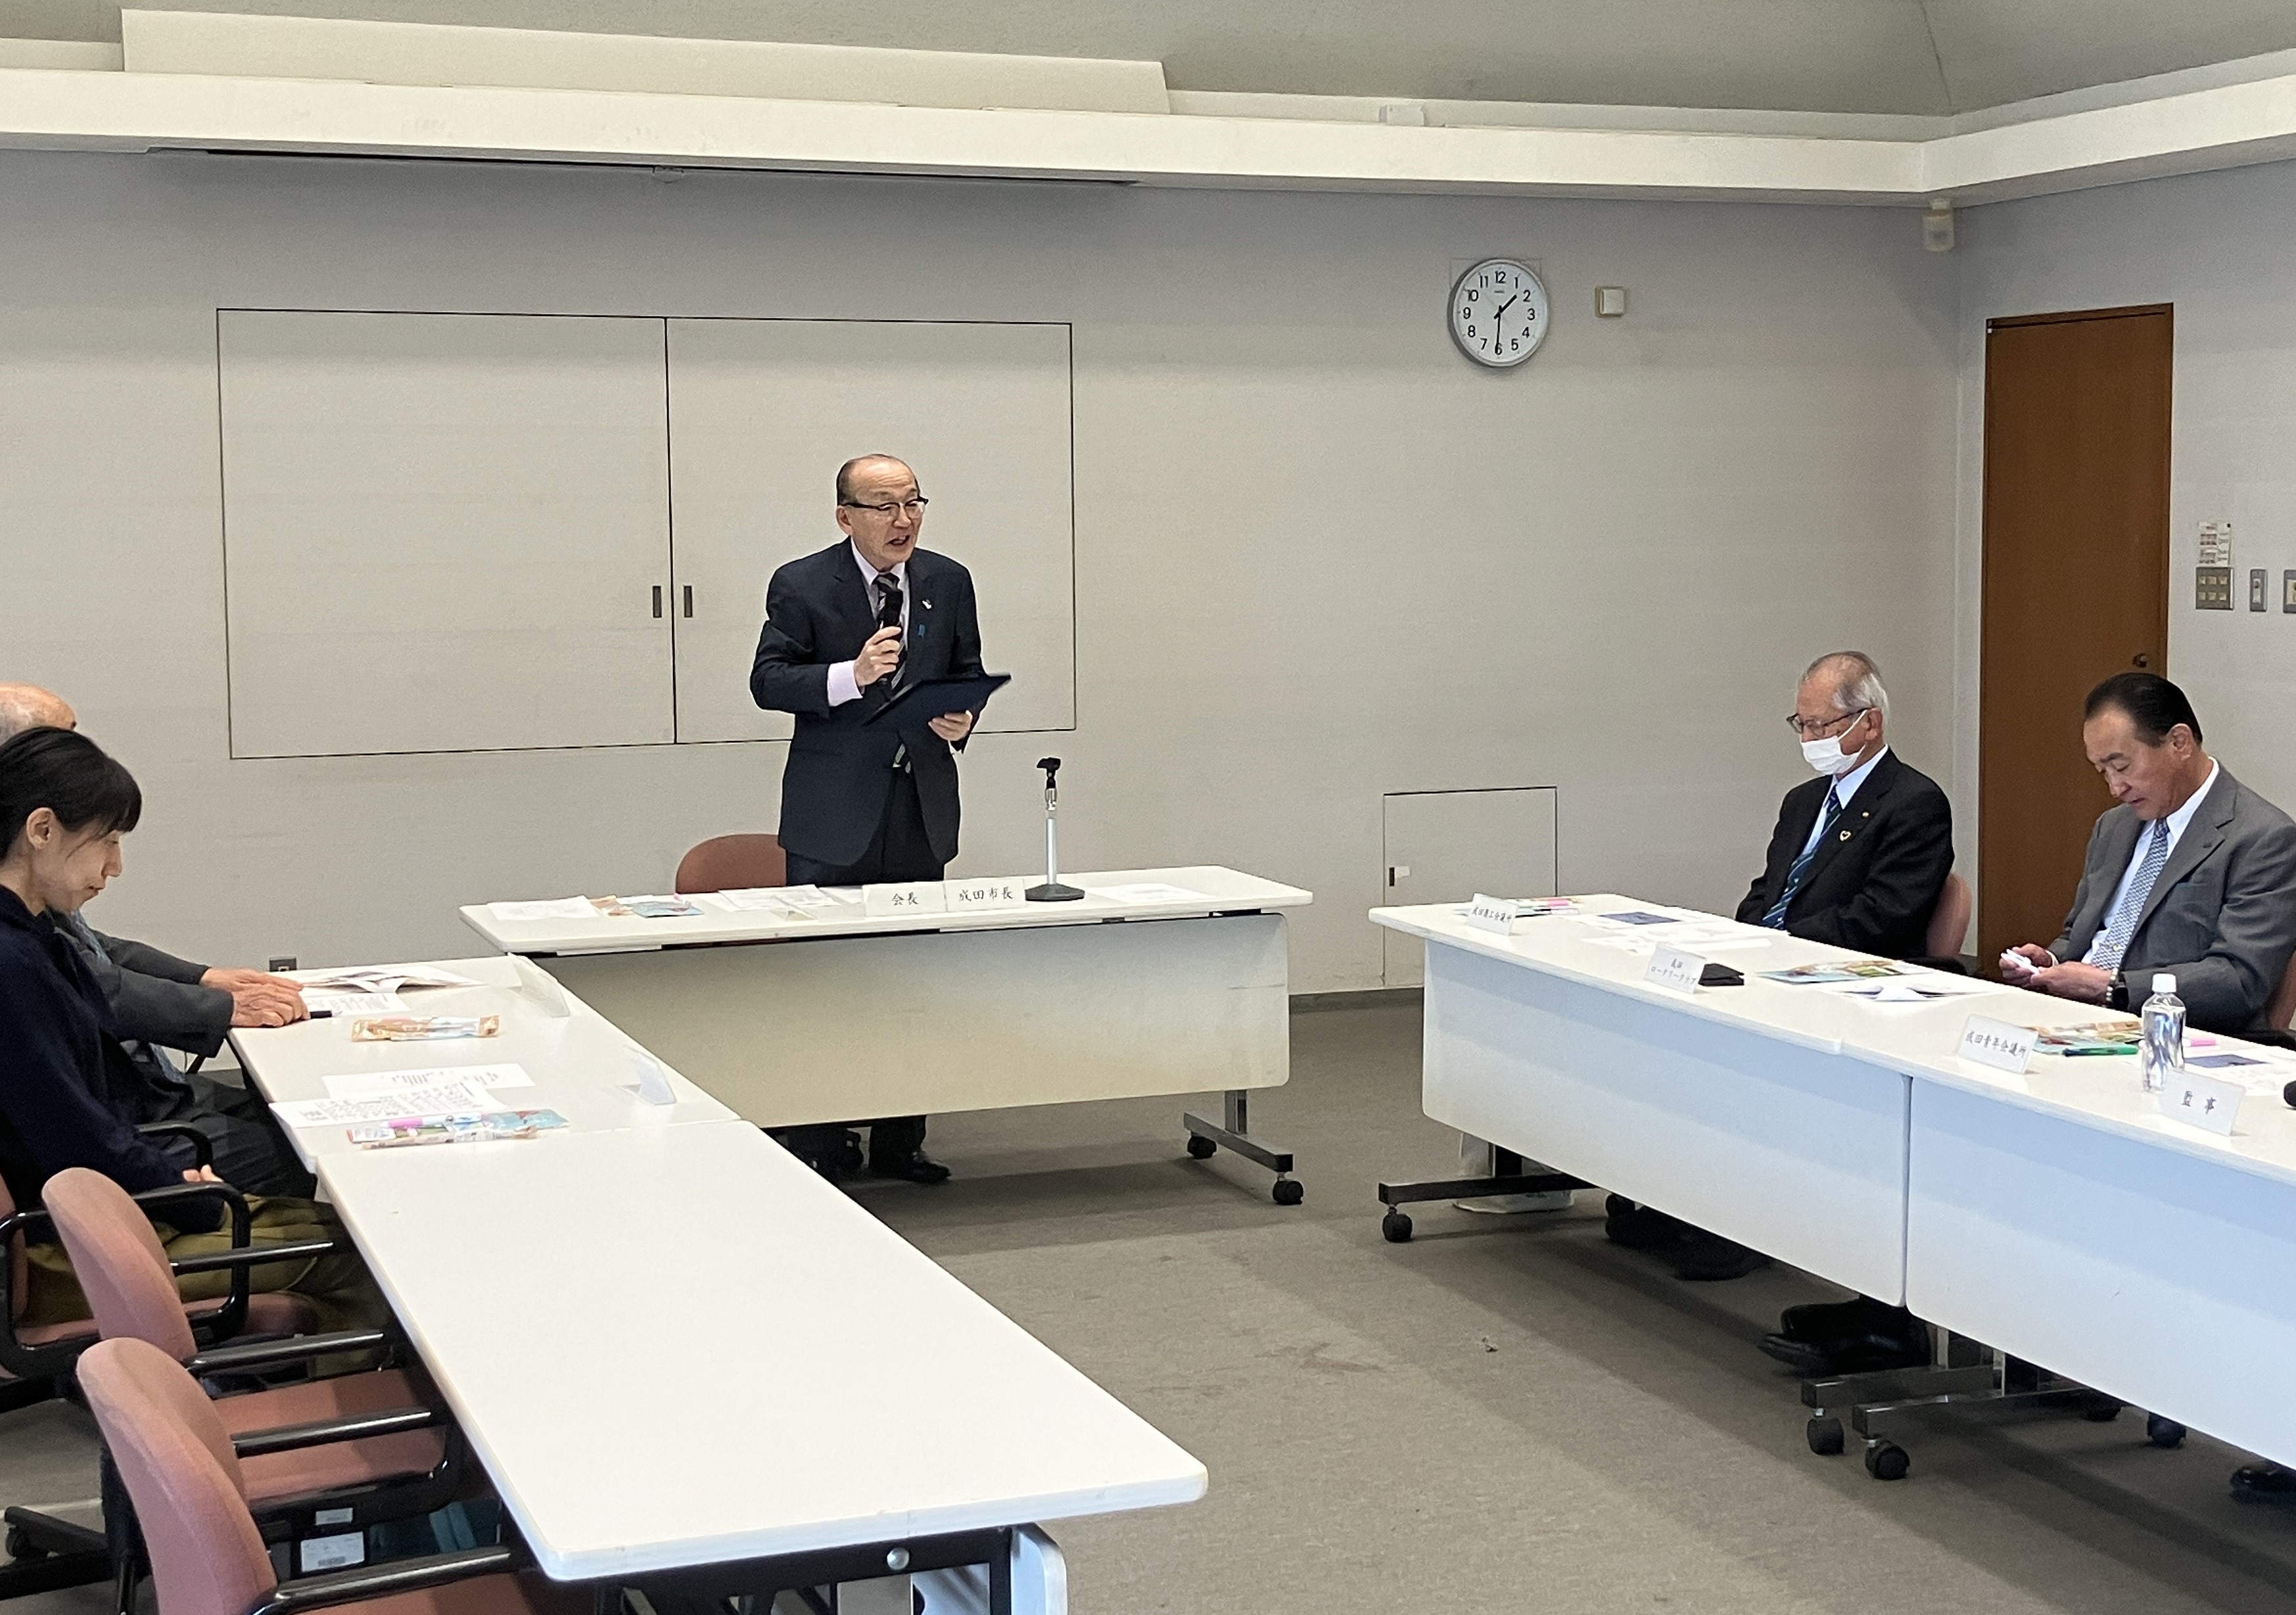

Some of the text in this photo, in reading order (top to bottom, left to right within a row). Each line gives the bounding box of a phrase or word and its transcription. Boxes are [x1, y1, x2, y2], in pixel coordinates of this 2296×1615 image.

[1480, 275, 1489, 288] 11
[1495, 271, 1506, 283] 12
[1514, 277, 1518, 289] 1
[1468, 289, 1478, 302] 10
[1523, 290, 1531, 302] 2
[1463, 307, 1471, 319] 9
[1527, 308, 1535, 320] 3
[1467, 325, 1476, 338] 8
[1522, 327, 1530, 339] 4
[1480, 338, 1487, 350] 7
[1495, 342, 1503, 355] 6
[1511, 339, 1519, 350] 5
[891, 892, 919, 906] 会長
[959, 886, 1013, 901] 成田市長
